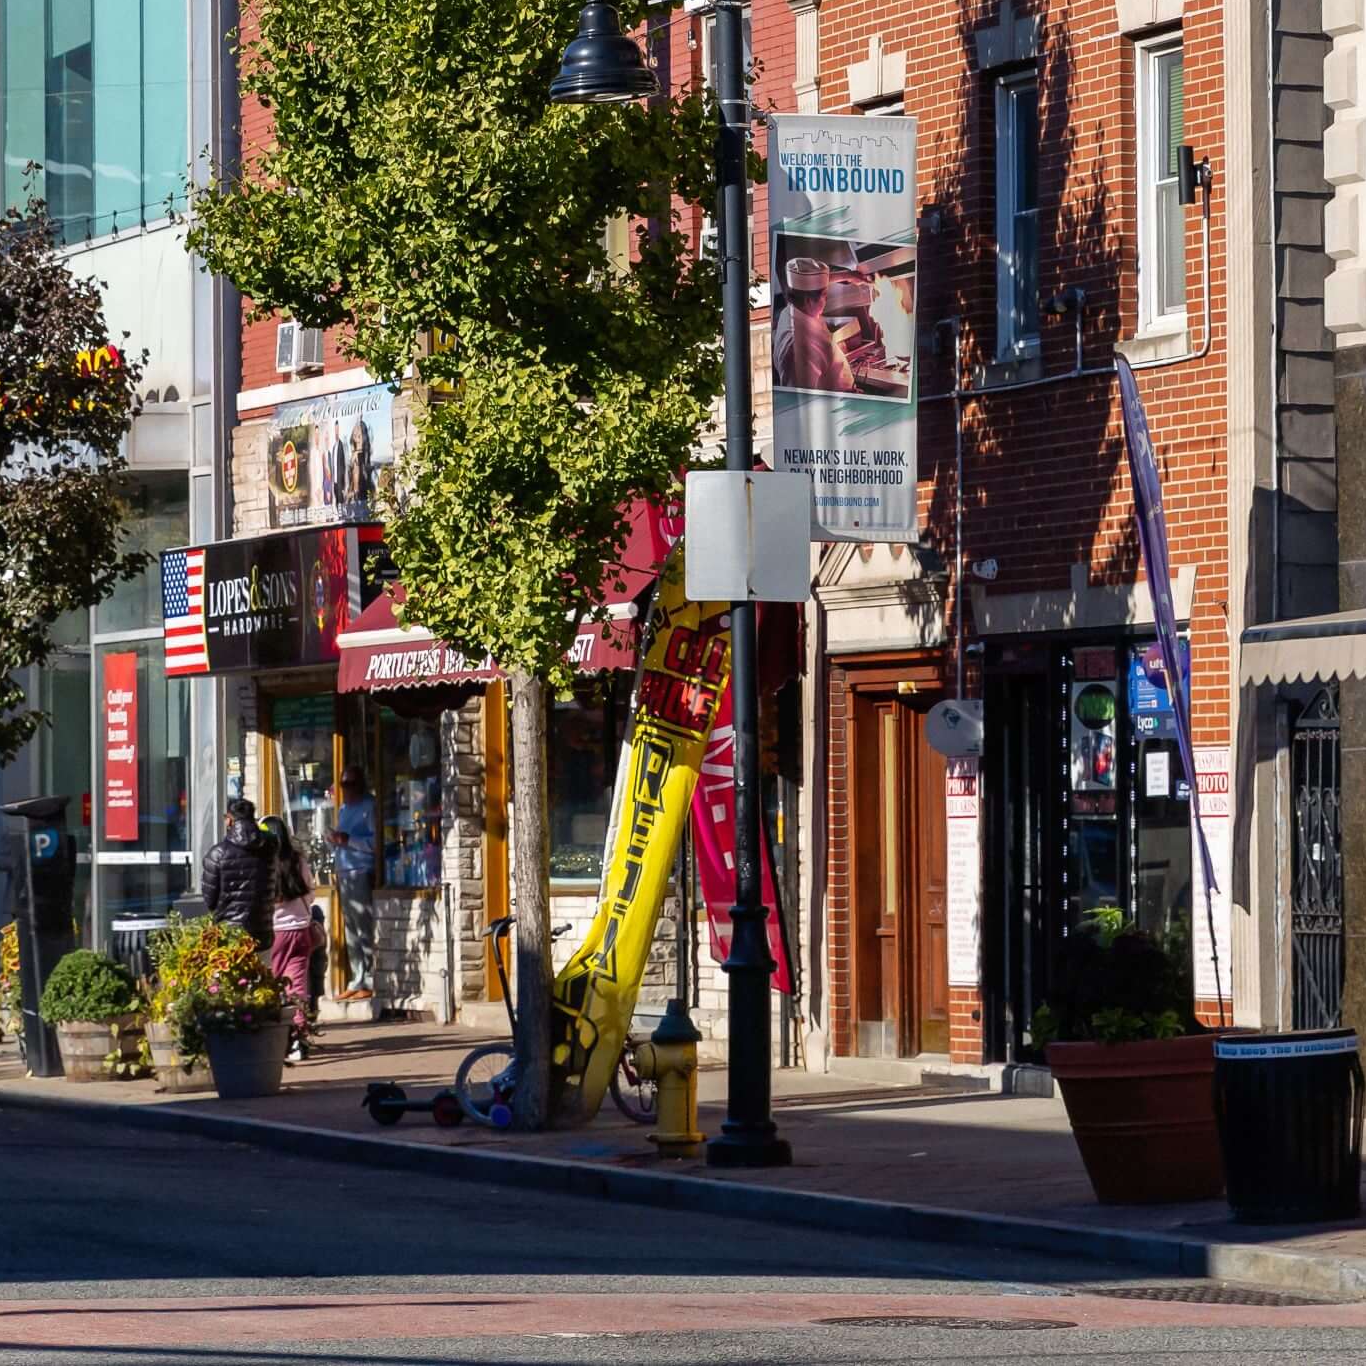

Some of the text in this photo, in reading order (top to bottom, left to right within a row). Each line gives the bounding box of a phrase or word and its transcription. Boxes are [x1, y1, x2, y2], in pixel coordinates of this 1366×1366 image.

[780, 153, 863, 168] WELCOME TO THE
[787, 166, 905, 194] IRONBOUND
[783, 449, 841, 465] NEWARK'S
[843, 450, 871, 467] LIVE,
[819, 468, 904, 485] NEIGHBORHOOD
[223, 613, 284, 637] HARDWARE
